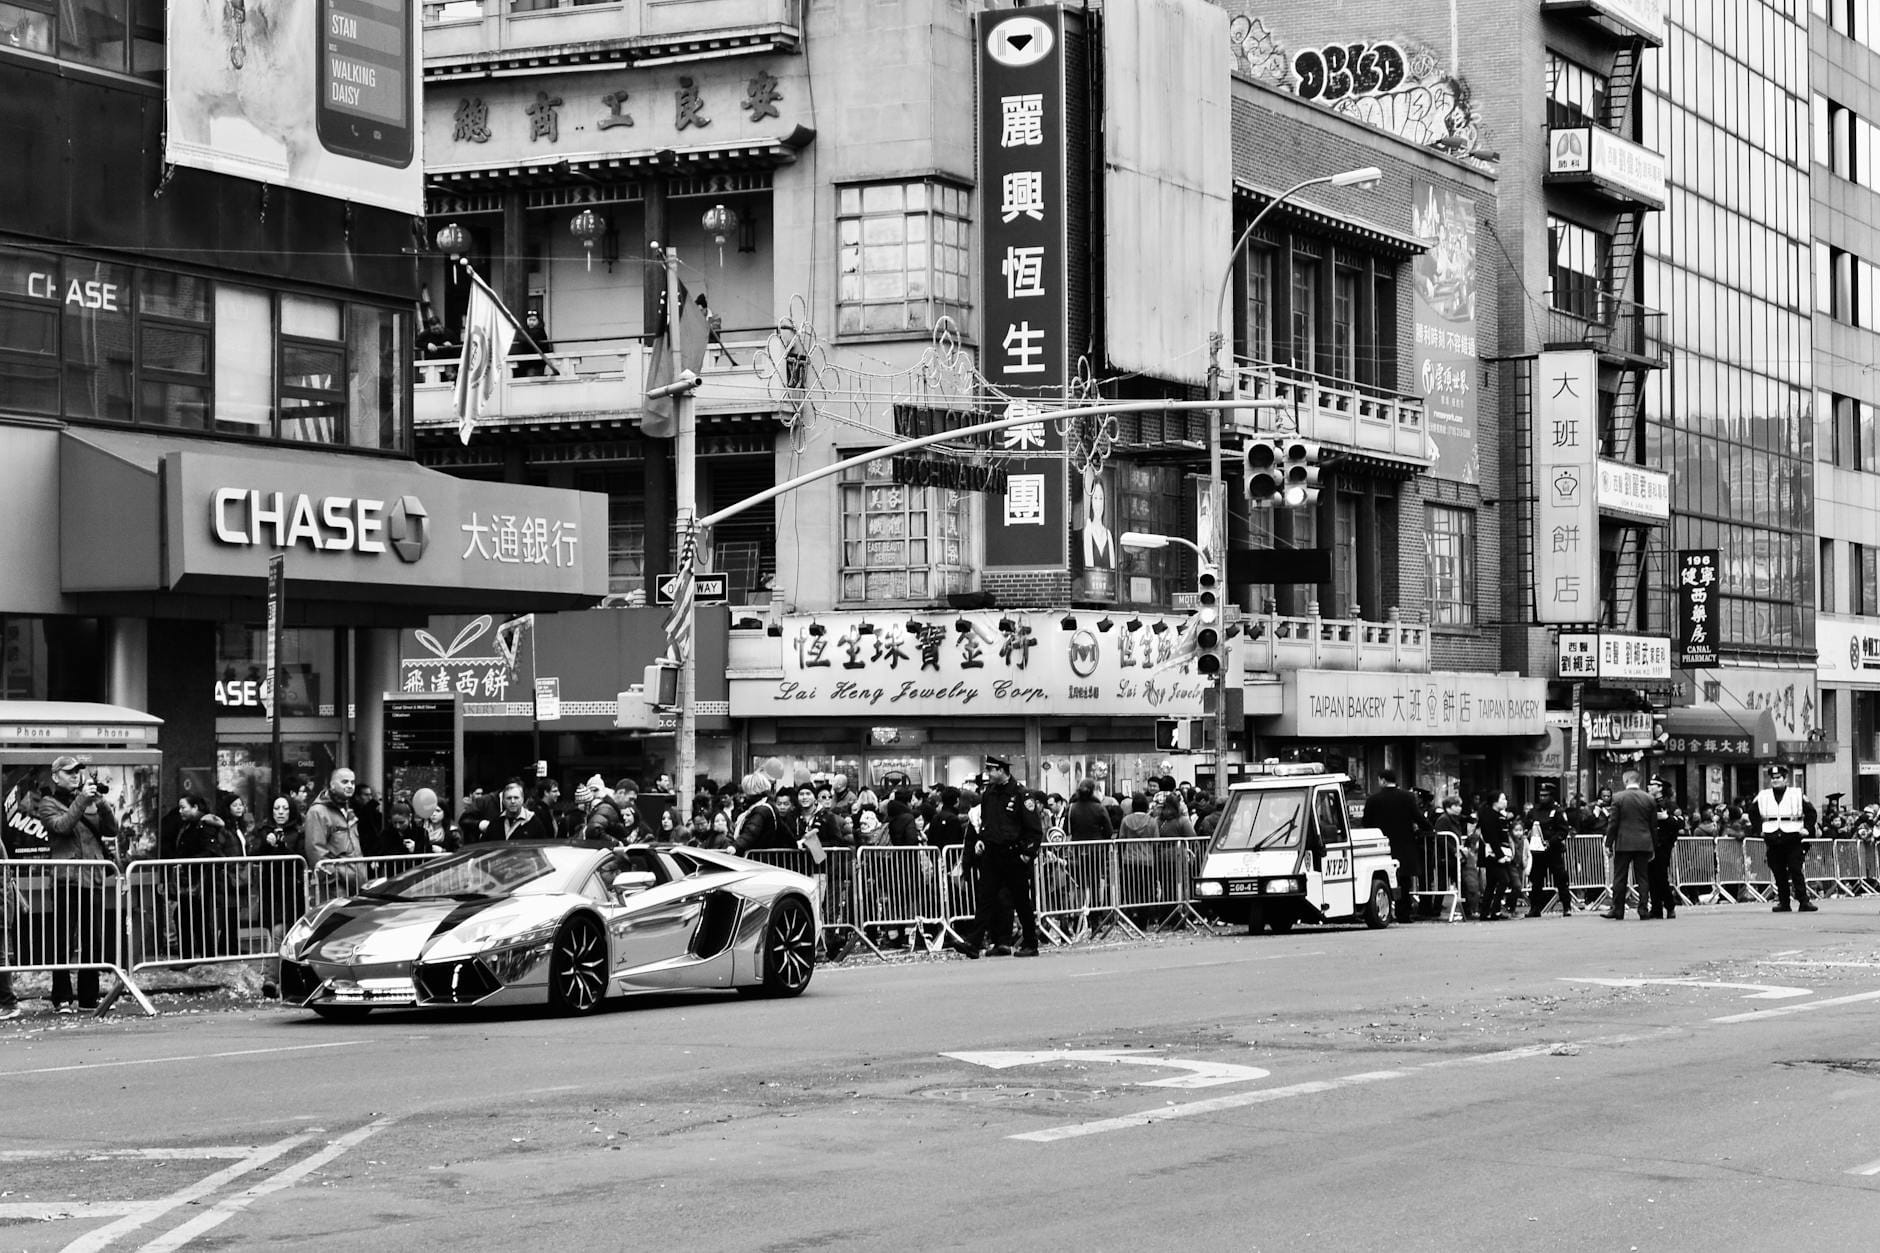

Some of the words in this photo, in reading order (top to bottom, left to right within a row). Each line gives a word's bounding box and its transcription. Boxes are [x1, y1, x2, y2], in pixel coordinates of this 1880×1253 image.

[332, 15, 357, 39] STAN
[332, 58, 376, 87] WALKING
[332, 82, 360, 106] DAISY
[28, 272, 118, 312] CHASE
[214, 487, 387, 553] CHASE
[460, 511, 578, 569] 大通銀行
[1687, 556, 1710, 565] 196
[696, 583, 717, 592] WAY
[1178, 595, 1198, 604] MOTT
[774, 682, 817, 701] Lai
[830, 681, 884, 705] Heng
[890, 681, 978, 704] Jewelry
[992, 680, 1048, 703] Corp.
[1310, 695, 1344, 718] TAIPAN
[1348, 695, 1386, 718] BAKERY
[1478, 699, 1505, 719] TAIPAN
[1508, 699, 1540, 720] BAKERY
[17, 726, 51, 737] Phone
[97, 727, 130, 737] Phone
[1592, 714, 1611, 738] at&t
[1325, 859, 1349, 876] NYPD
